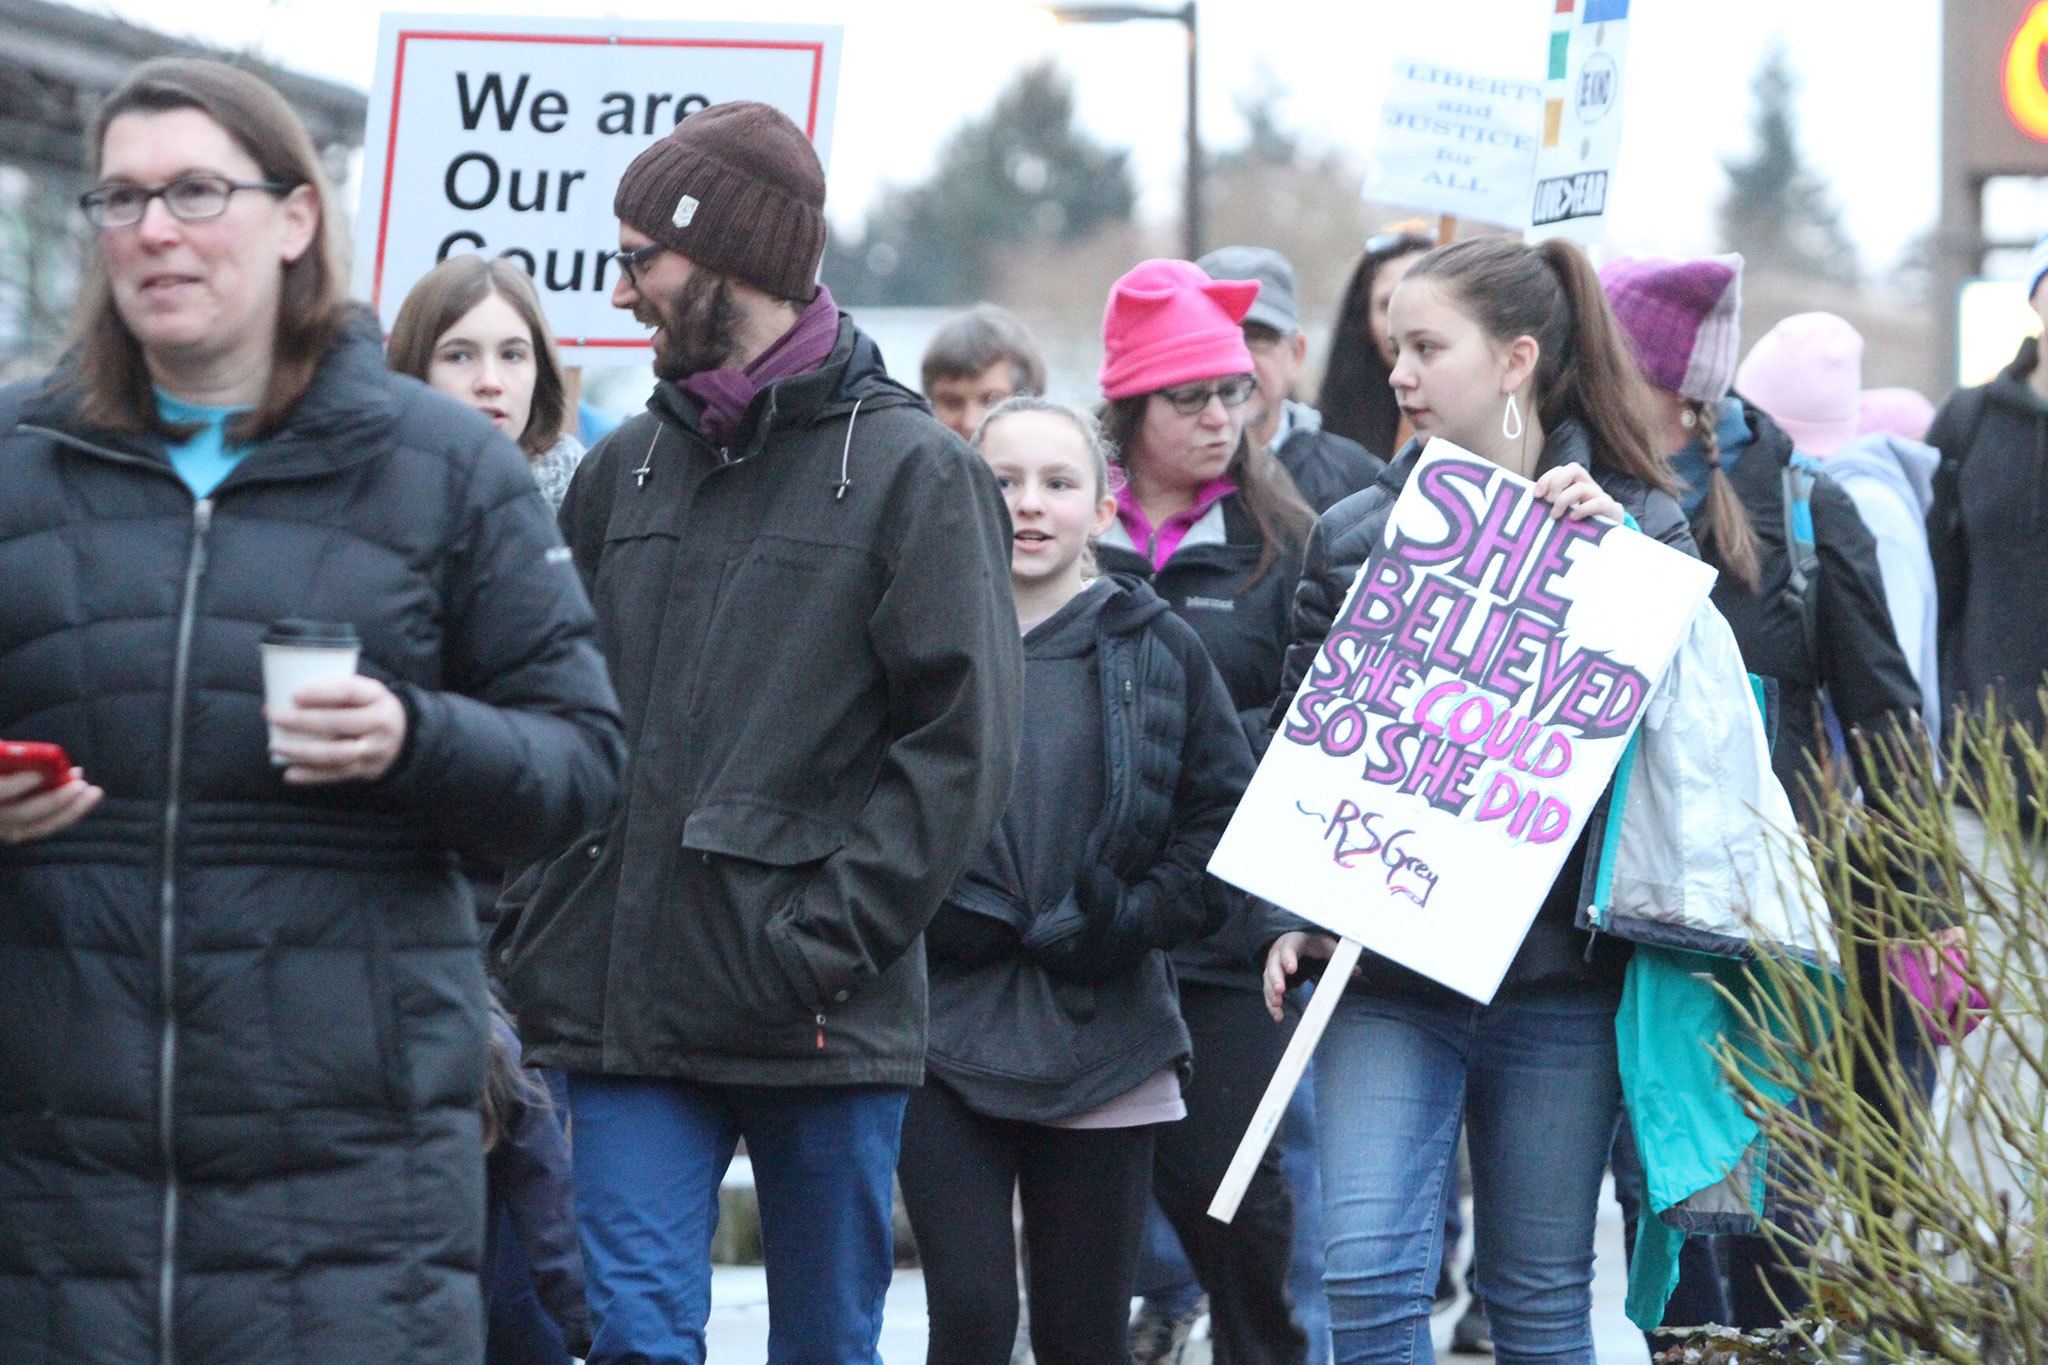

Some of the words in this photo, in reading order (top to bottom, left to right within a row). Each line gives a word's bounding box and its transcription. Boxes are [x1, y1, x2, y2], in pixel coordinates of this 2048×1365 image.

[456, 71, 568, 133] We
[1386, 112, 1534, 150] JUSTICE
[1437, 98, 1493, 119] and
[444, 151, 585, 212] Our
[1422, 168, 1490, 194] ALL
[1435, 145, 1478, 166] for
[1397, 458, 1617, 627] SHE
[1346, 557, 1649, 738] BELIEVED
[1310, 629, 1428, 720] SHE
[1413, 680, 1572, 778] COULD
[1284, 690, 1367, 756] SO
[1362, 722, 1487, 816] SHE
[1475, 771, 1570, 843] DID
